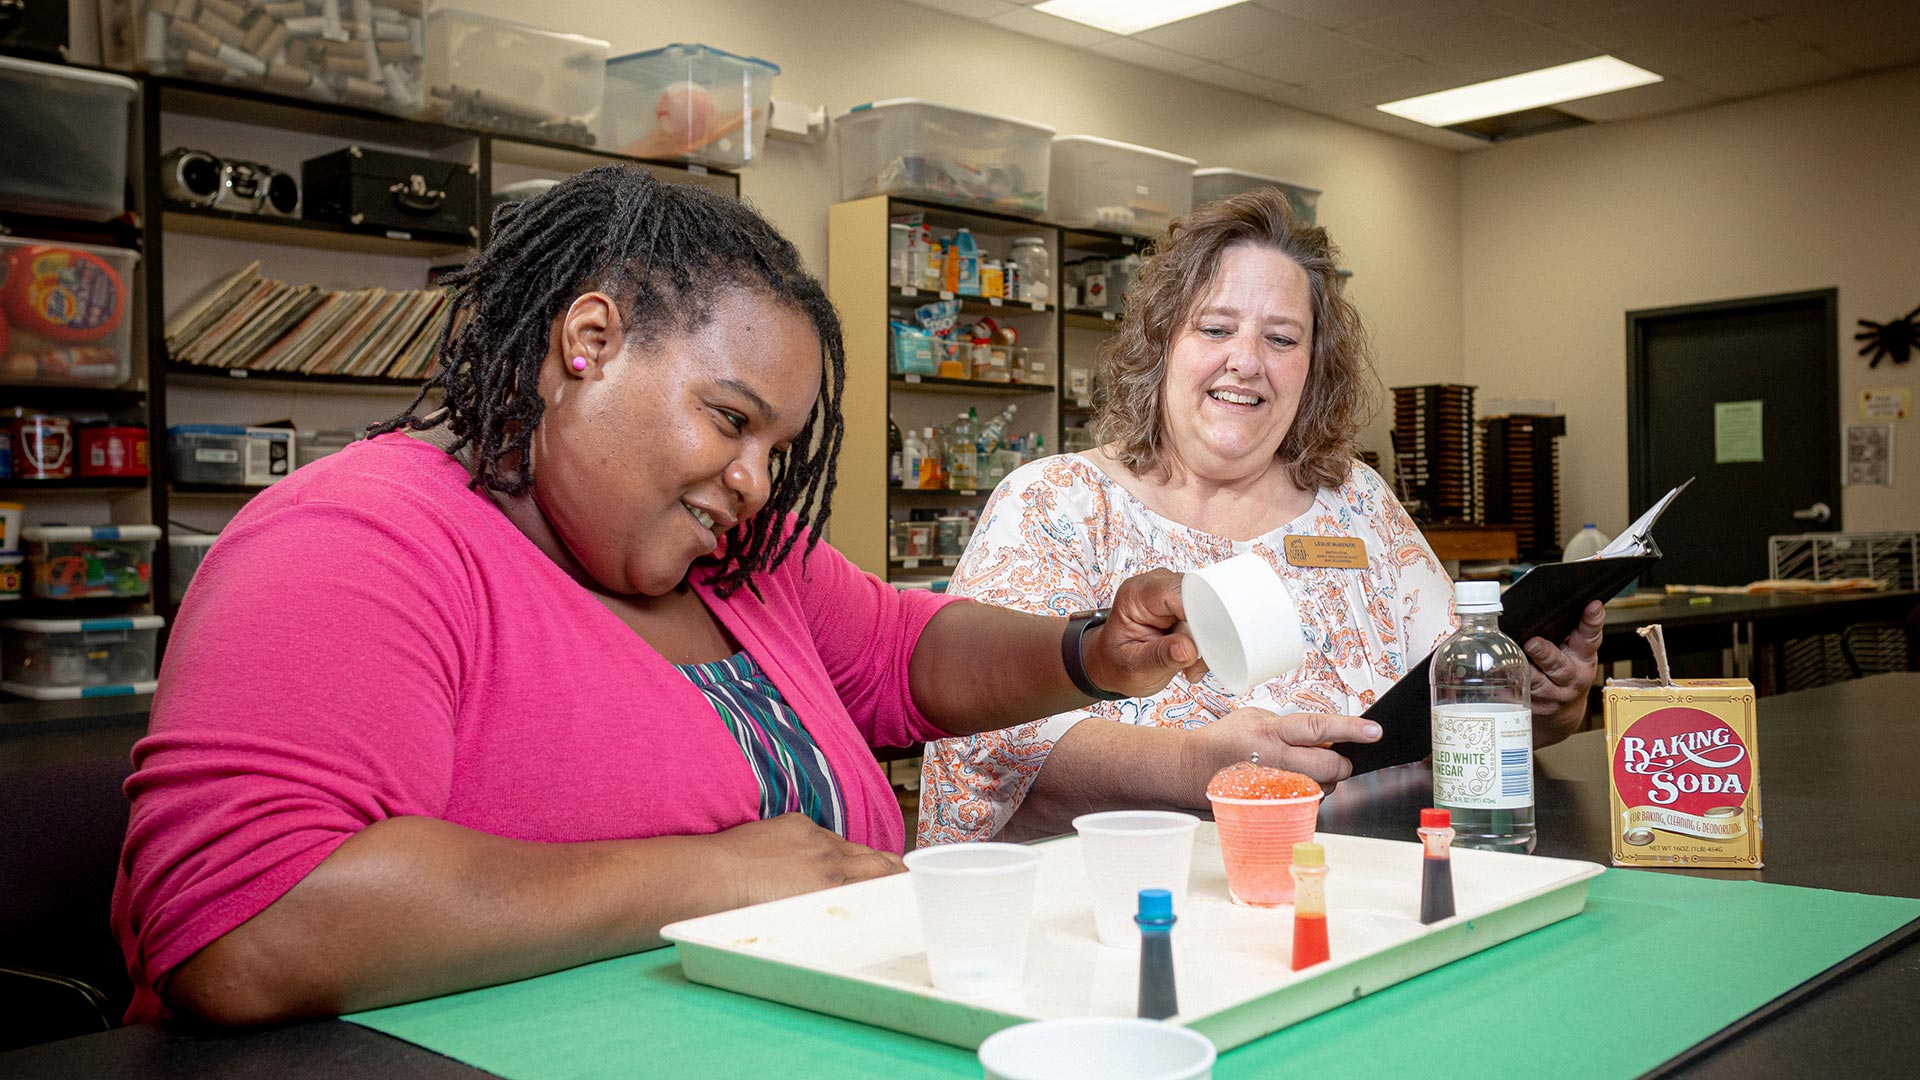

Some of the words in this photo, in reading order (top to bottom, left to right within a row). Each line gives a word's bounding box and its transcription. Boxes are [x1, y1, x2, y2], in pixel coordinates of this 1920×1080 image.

[1453, 752, 1485, 765] WHITE
[1623, 728, 1744, 775] BAKING
[1648, 772, 1744, 805] SODA
[1630, 810, 1641, 824] FOR
[1642, 810, 1666, 826] BAKING,
[1667, 814, 1696, 832] CLEANING
[1696, 822, 1701, 832] &
[1703, 822, 1741, 835] DEODORIZING
